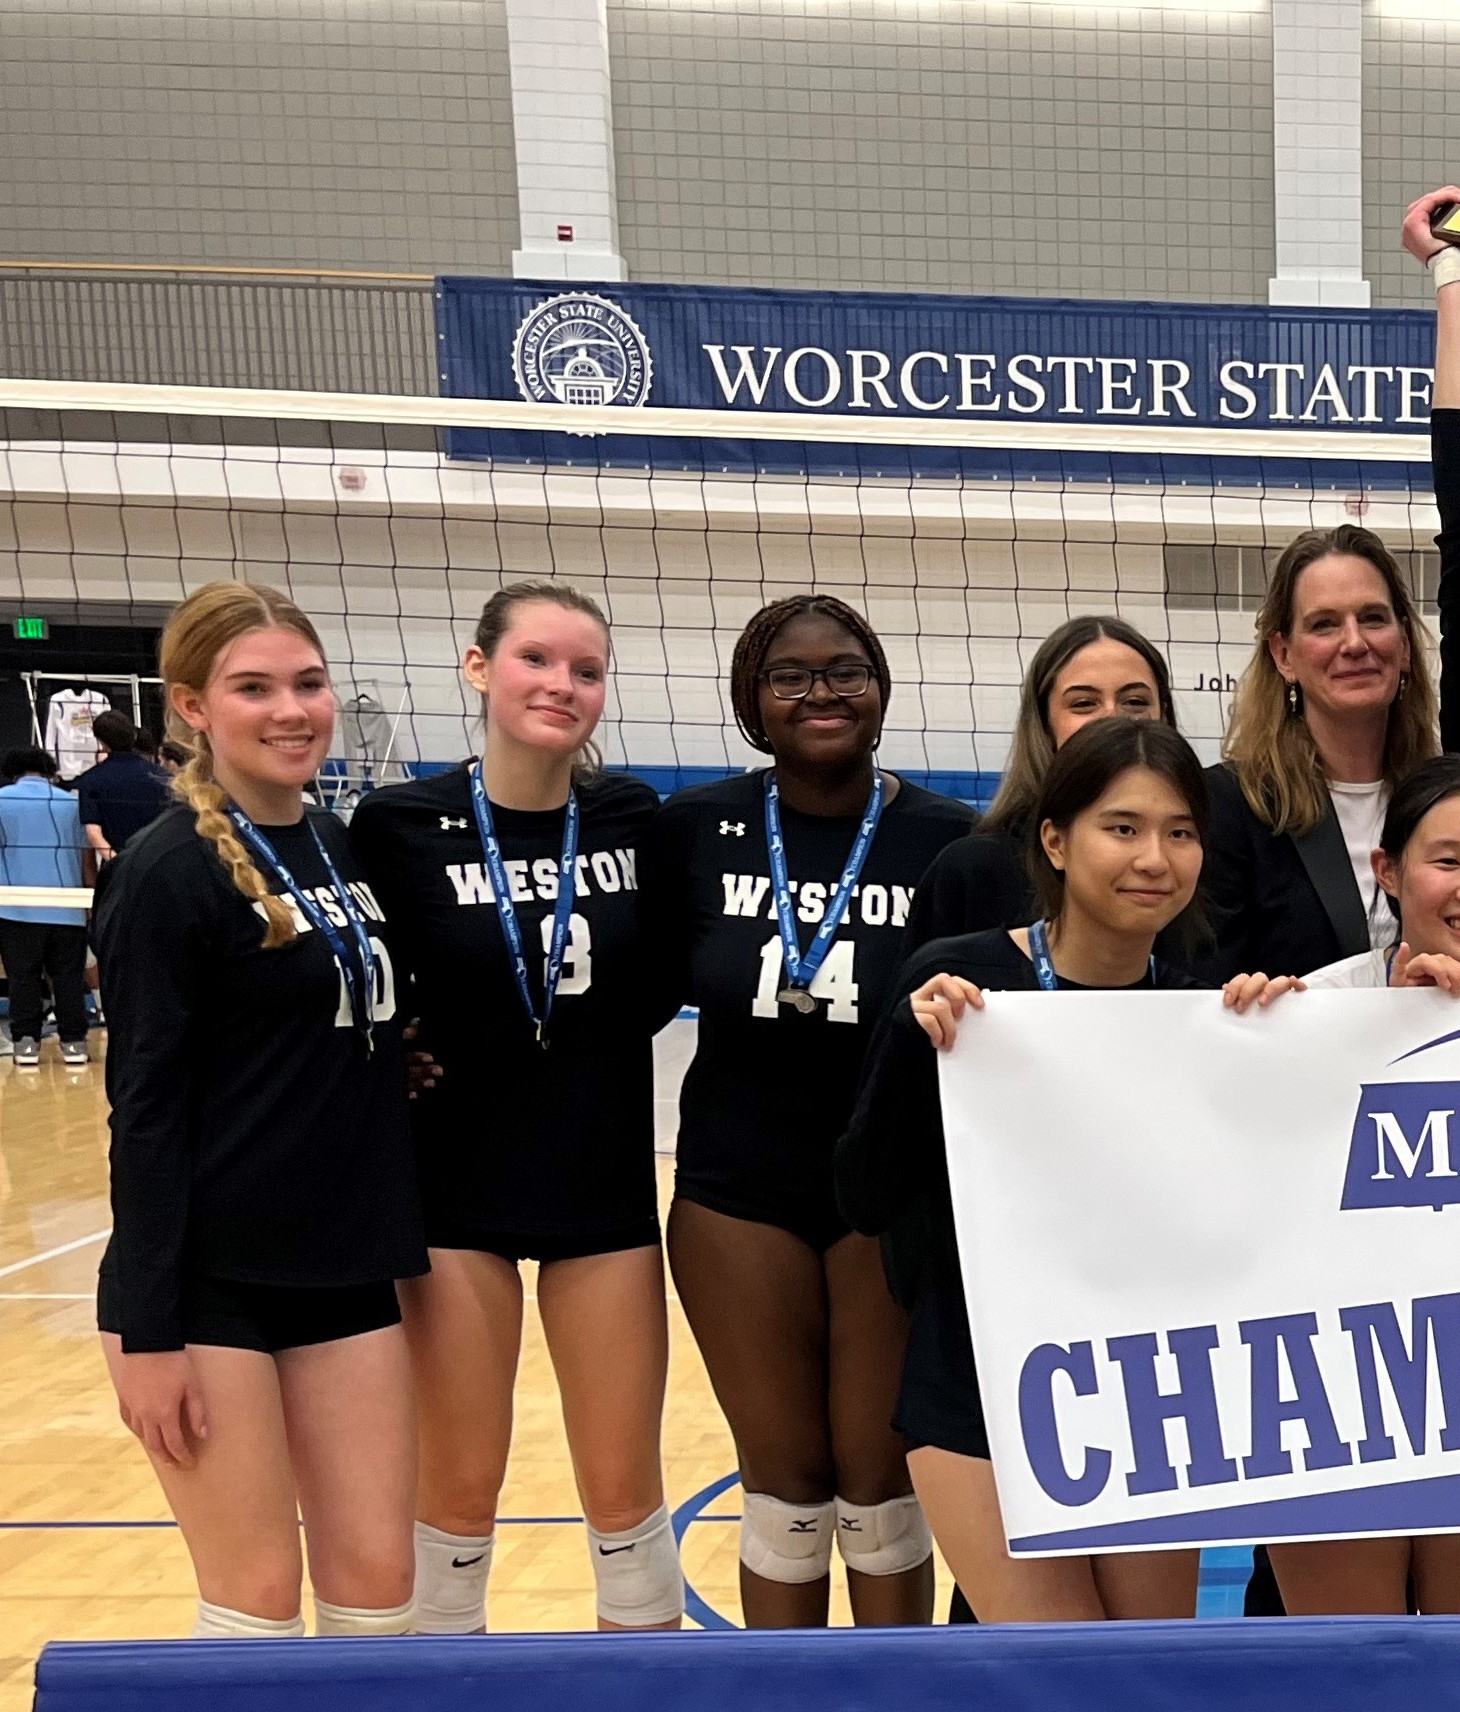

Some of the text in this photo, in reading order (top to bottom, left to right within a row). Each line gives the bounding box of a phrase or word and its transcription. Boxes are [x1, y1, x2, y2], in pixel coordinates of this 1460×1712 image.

[524, 304, 642, 405] WORCESTER STATE UNIVERSITY
[702, 344, 1197, 417] WORCESTER
[1219, 360, 1435, 424] STATE
[445, 848, 638, 905] WESTON
[752, 934, 859, 1024] 14
